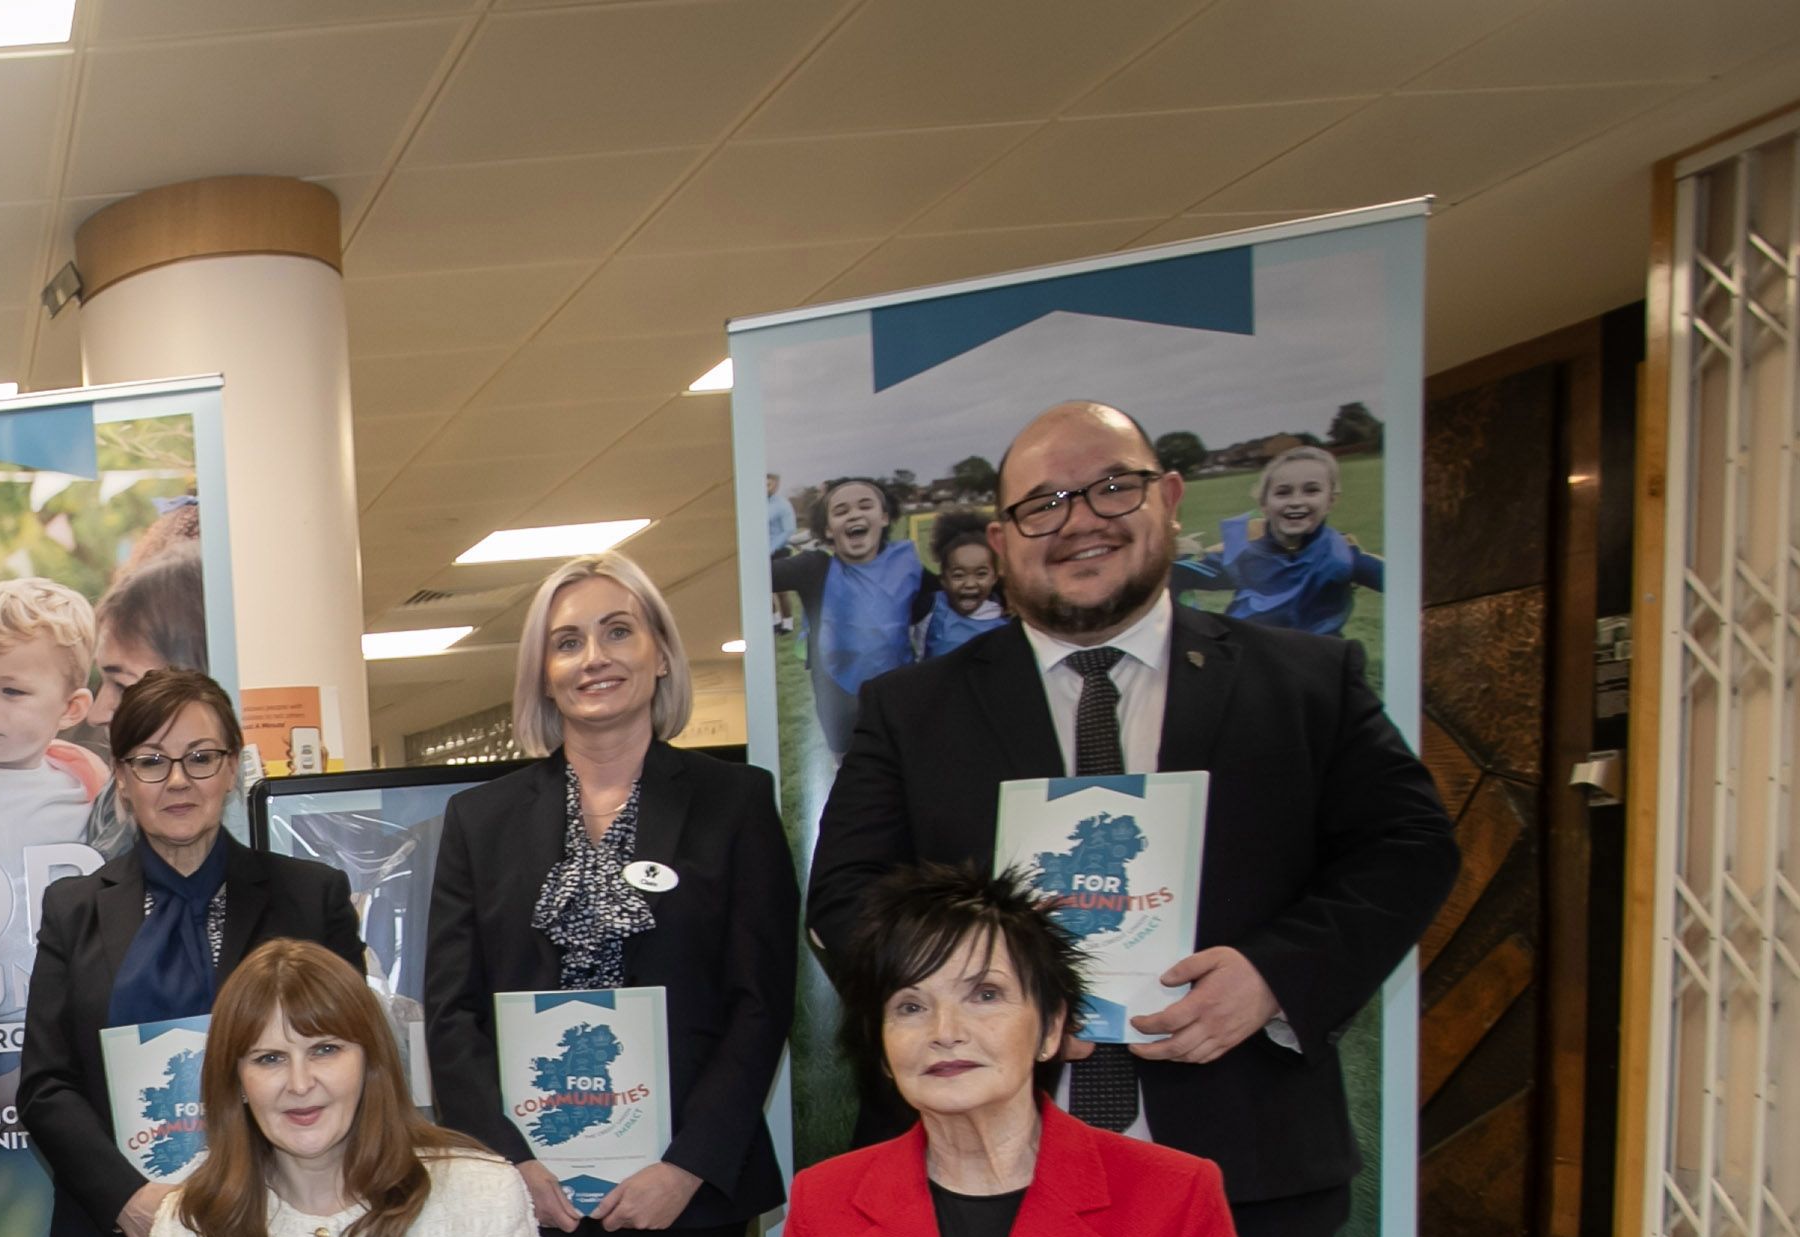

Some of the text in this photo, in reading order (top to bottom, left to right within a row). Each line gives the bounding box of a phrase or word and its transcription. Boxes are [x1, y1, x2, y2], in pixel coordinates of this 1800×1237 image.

[1072, 873, 1122, 893] FOR
[566, 1075, 606, 1091] FOR
[514, 1083, 650, 1117] COMMUNITIES
